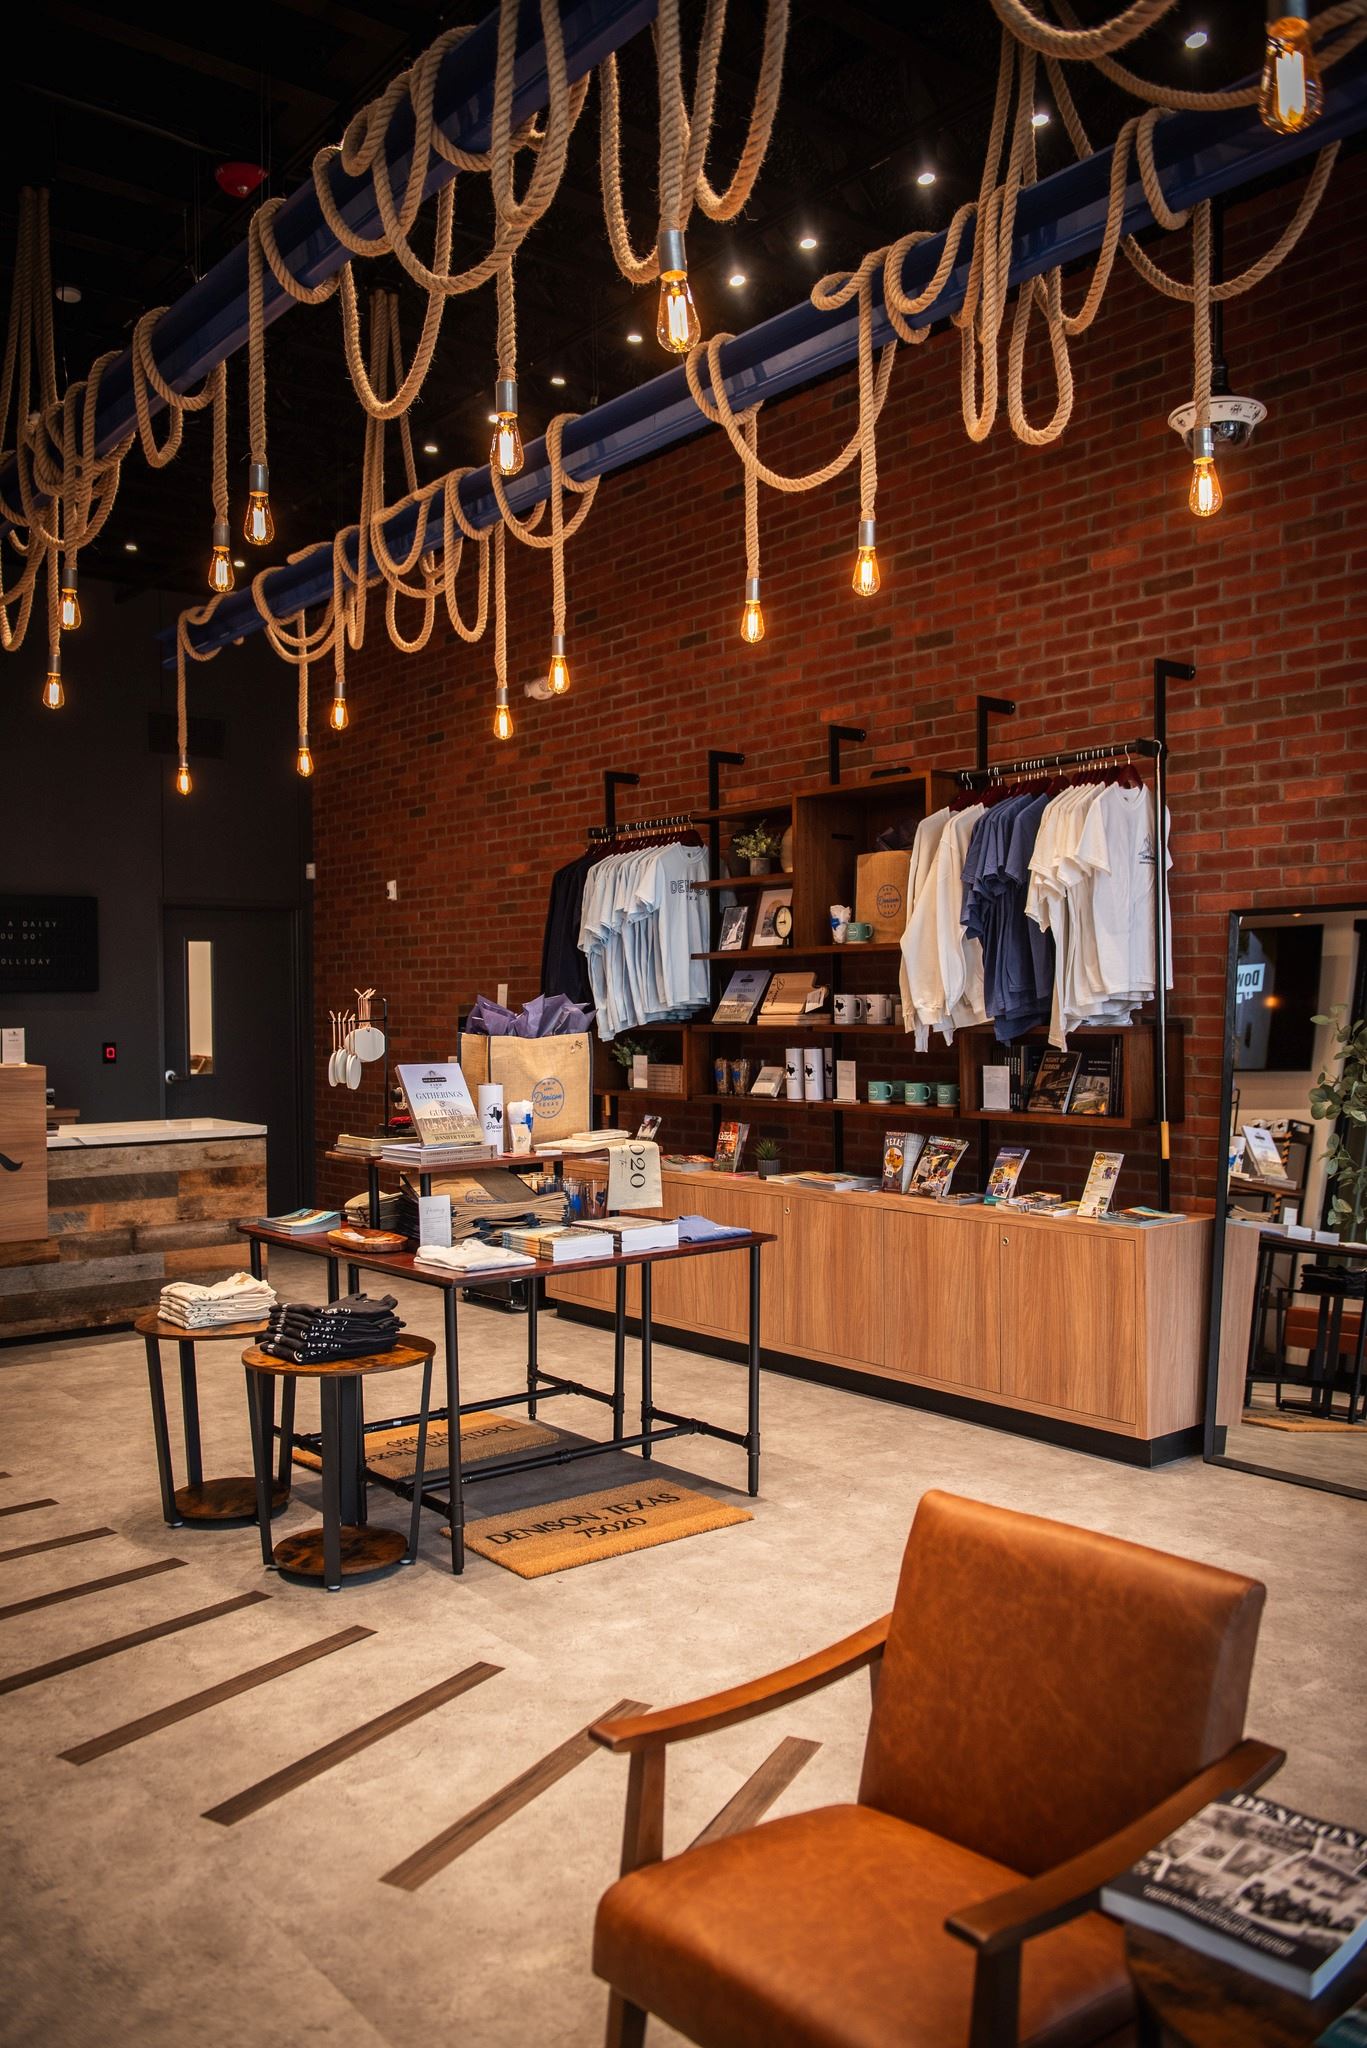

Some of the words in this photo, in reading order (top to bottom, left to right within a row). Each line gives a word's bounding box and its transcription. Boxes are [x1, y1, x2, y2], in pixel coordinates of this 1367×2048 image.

[415, 1090, 464, 1101] GATHERINGS
[885, 1137, 904, 1148] TEXAS
[602, 1493, 681, 1516] TEXAS
[574, 1517, 647, 1539] 75020
